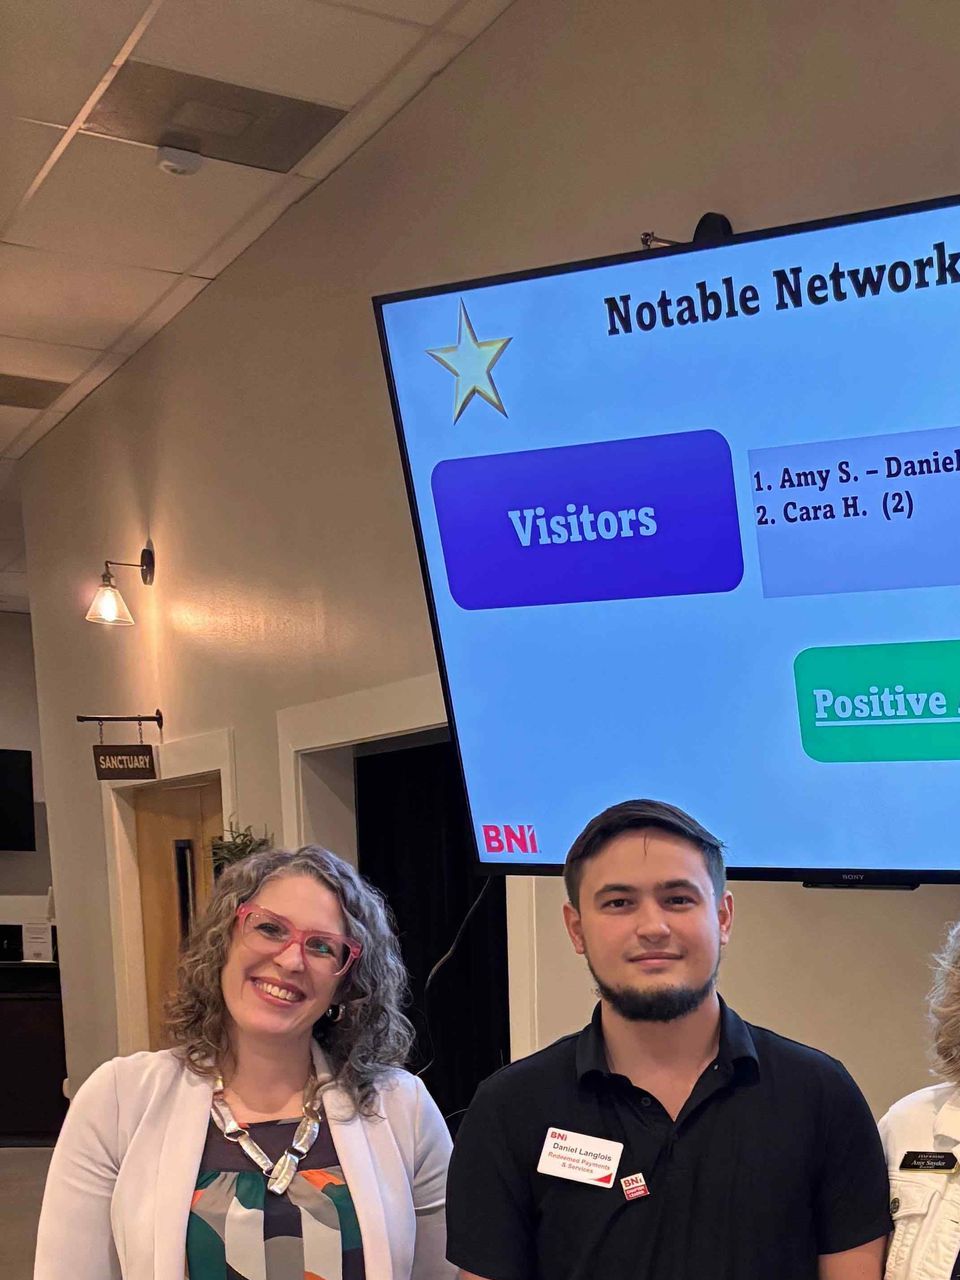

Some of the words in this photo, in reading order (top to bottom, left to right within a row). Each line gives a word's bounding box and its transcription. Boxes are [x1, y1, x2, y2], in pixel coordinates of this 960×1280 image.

[604, 276, 760, 336] Notable
[753, 471, 772, 491] 1.
[780, 467, 830, 492] Amy
[838, 461, 858, 483] S.
[508, 503, 657, 547] Visitors
[756, 505, 776, 526] 2.
[783, 501, 836, 523] Cara
[842, 496, 867, 518] H.
[882, 491, 914, 521] (2)
[813, 685, 947, 719] Positive
[100, 755, 150, 769] SANCTUARY
[553, 1142, 578, 1154] Daniel
[579, 1148, 612, 1161] Langlois
